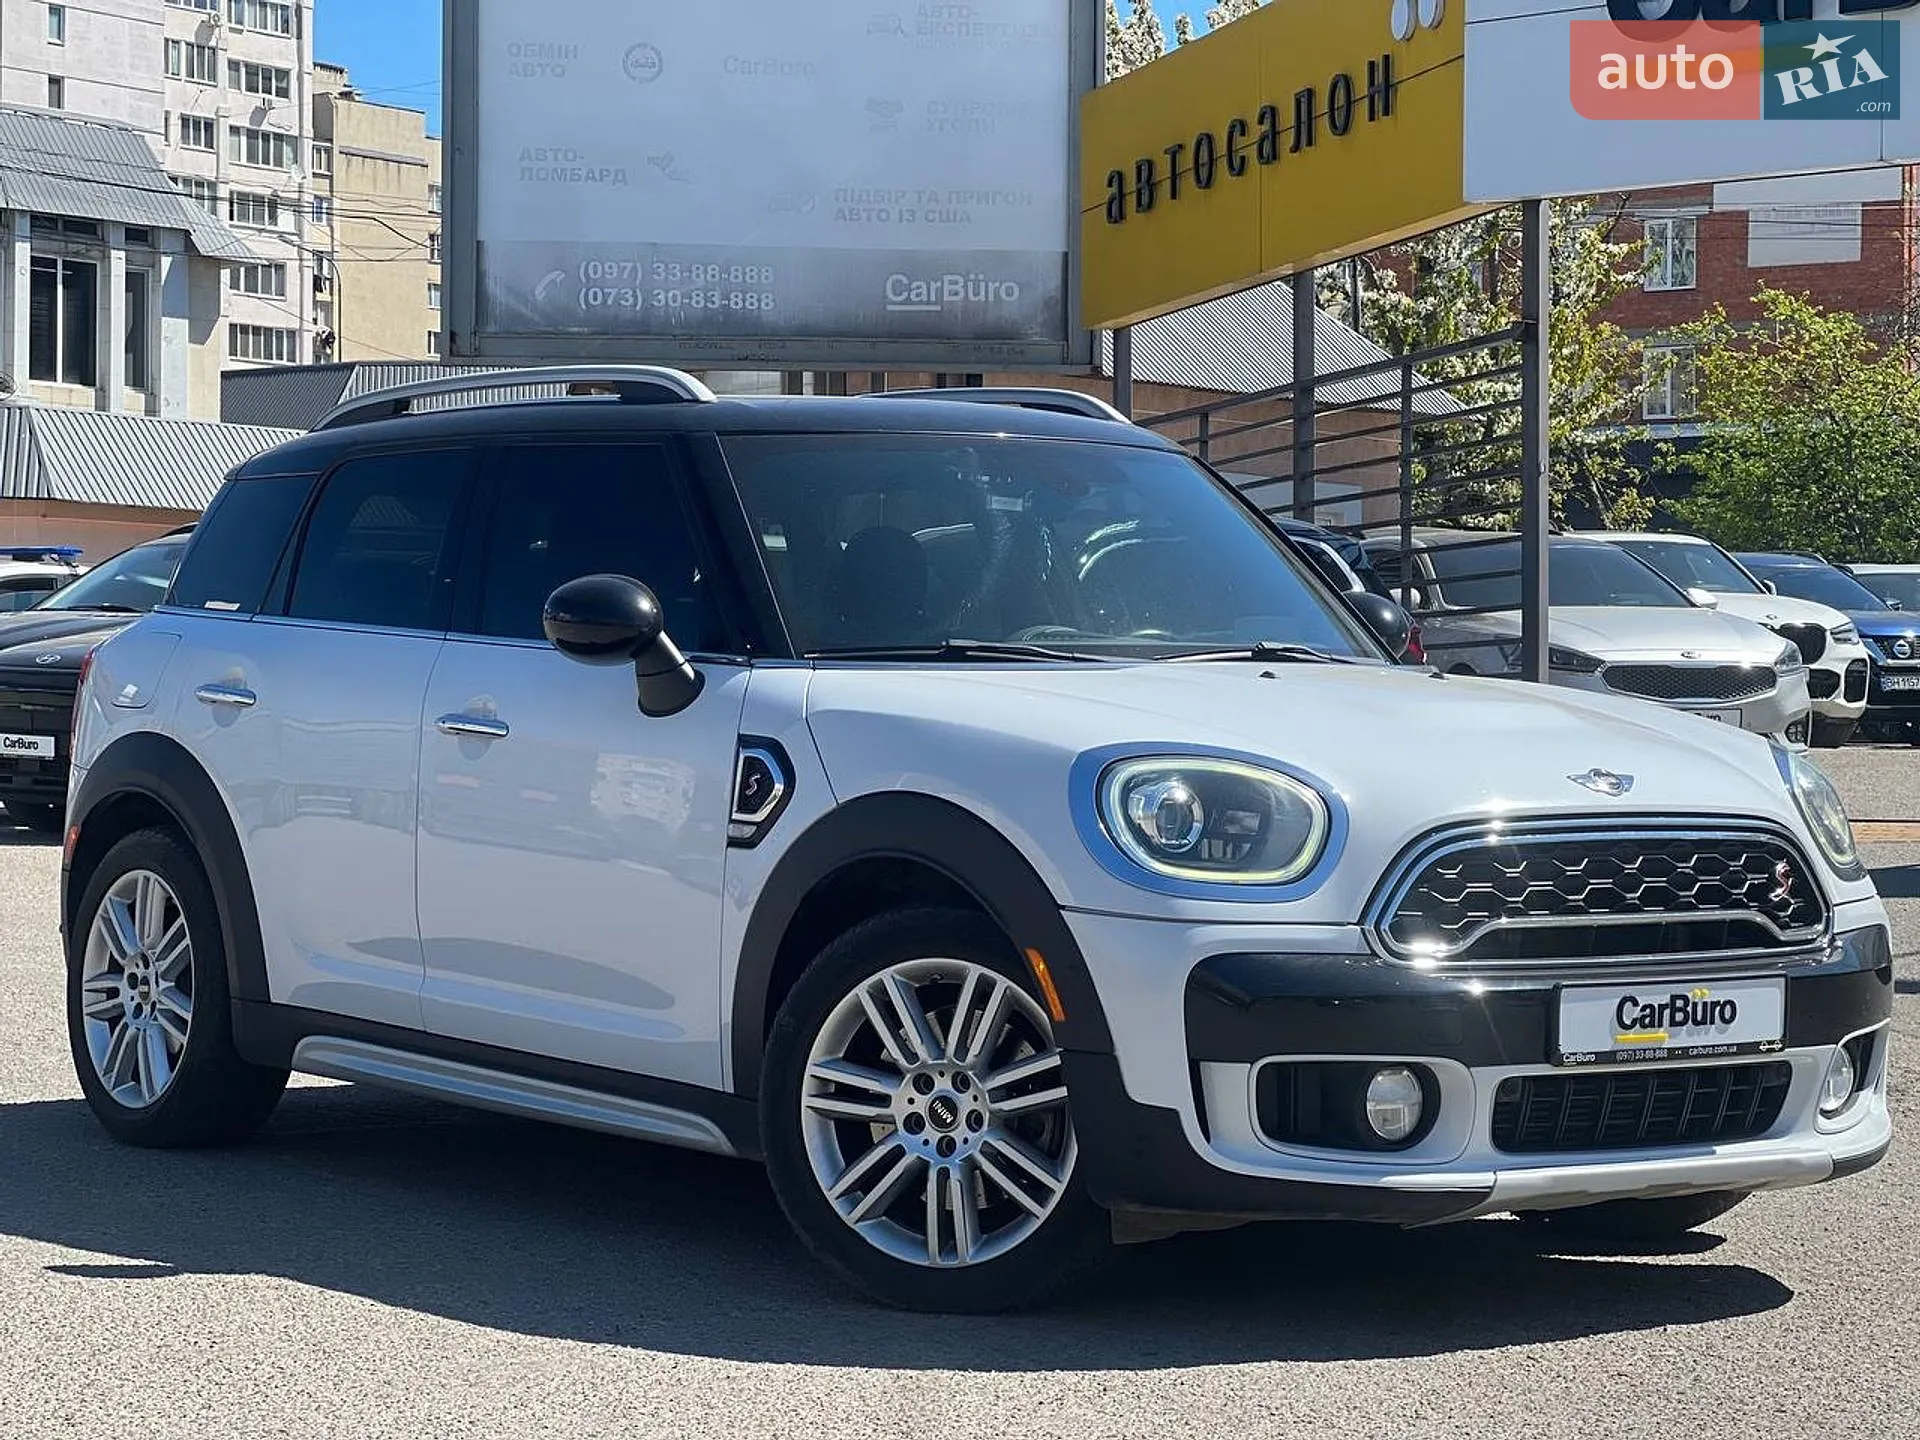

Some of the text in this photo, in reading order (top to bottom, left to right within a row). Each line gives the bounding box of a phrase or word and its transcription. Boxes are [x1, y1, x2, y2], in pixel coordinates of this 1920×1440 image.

[1106, 53, 1393, 225] автосалон
[580, 261, 774, 287] (097) 33-88-888
[580, 287, 642, 311] (073)
[886, 274, 1020, 302] CarBüro
[1616, 988, 1738, 1031] CarBüro
[932, 1100, 954, 1124] MINI
